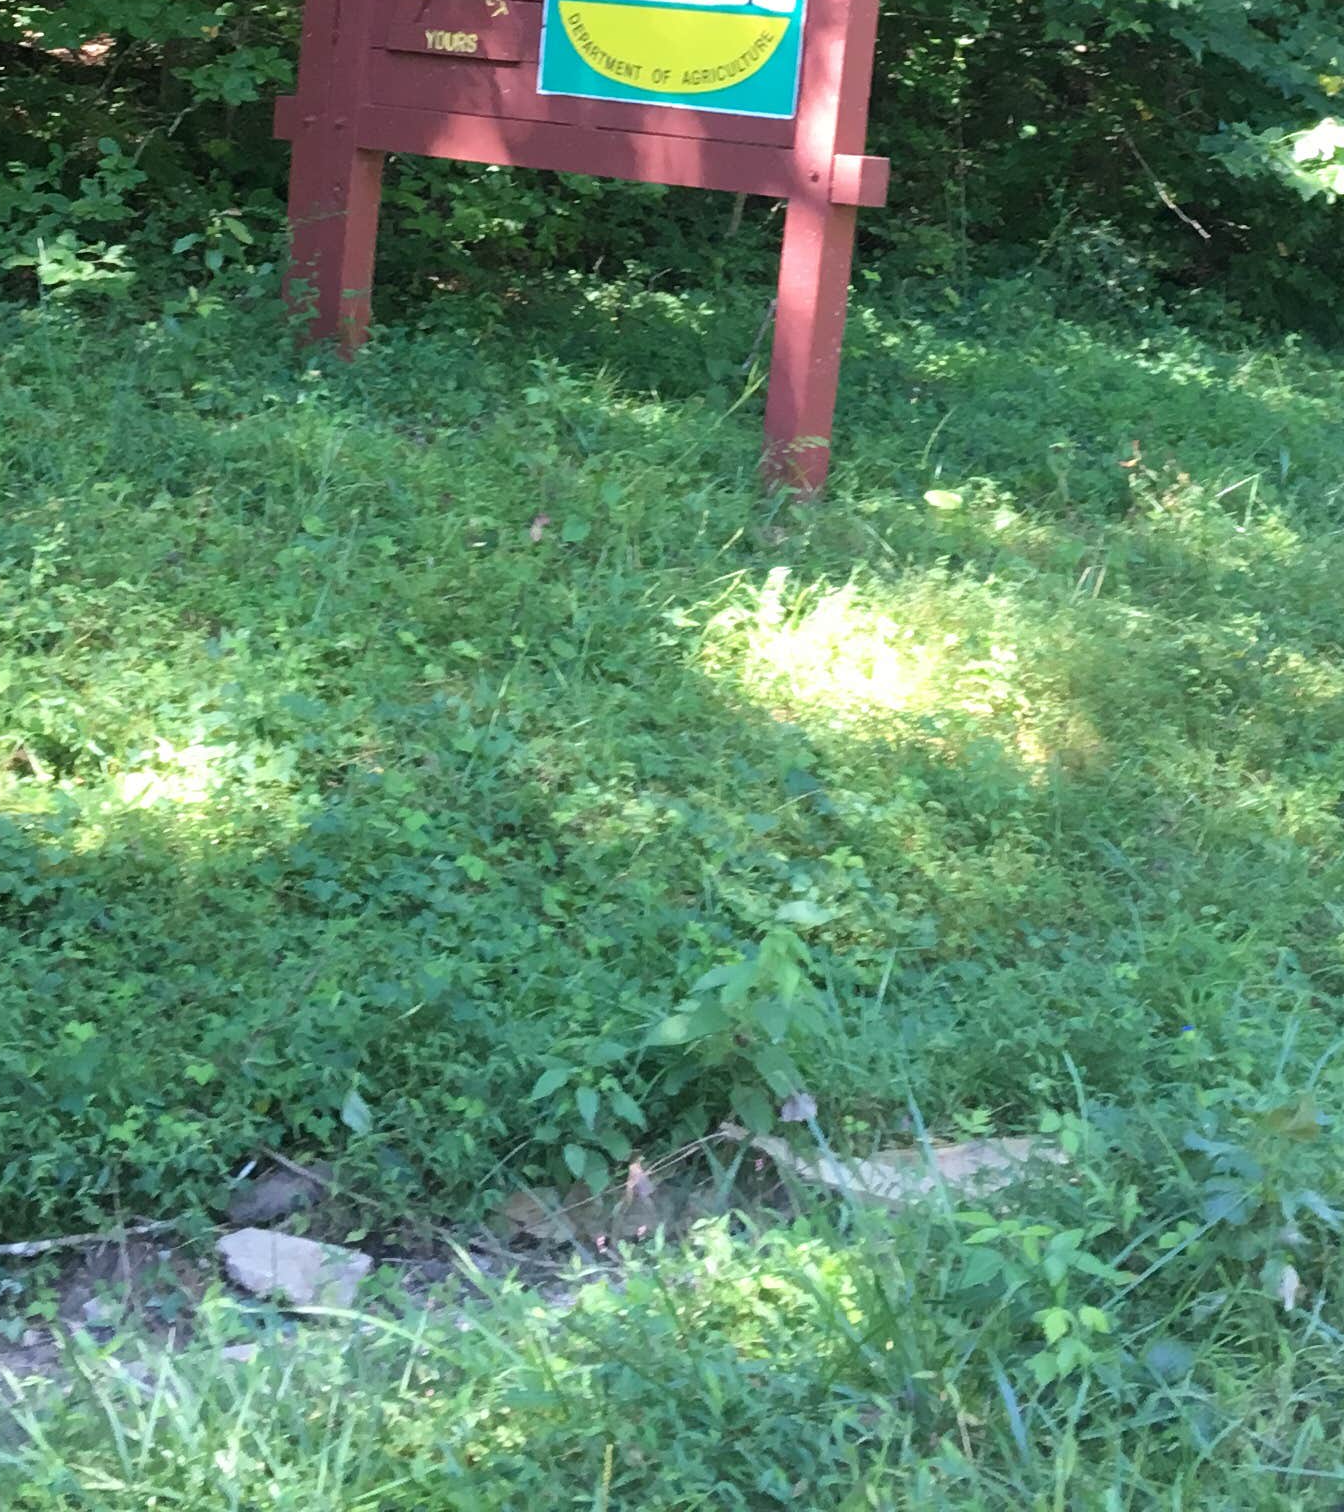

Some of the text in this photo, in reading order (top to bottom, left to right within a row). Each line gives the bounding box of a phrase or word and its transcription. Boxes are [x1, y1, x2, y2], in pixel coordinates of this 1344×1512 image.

[424, 29, 479, 54] YOURS
[567, 13, 775, 86] DEPARTMENT OF AGRICULTURE
